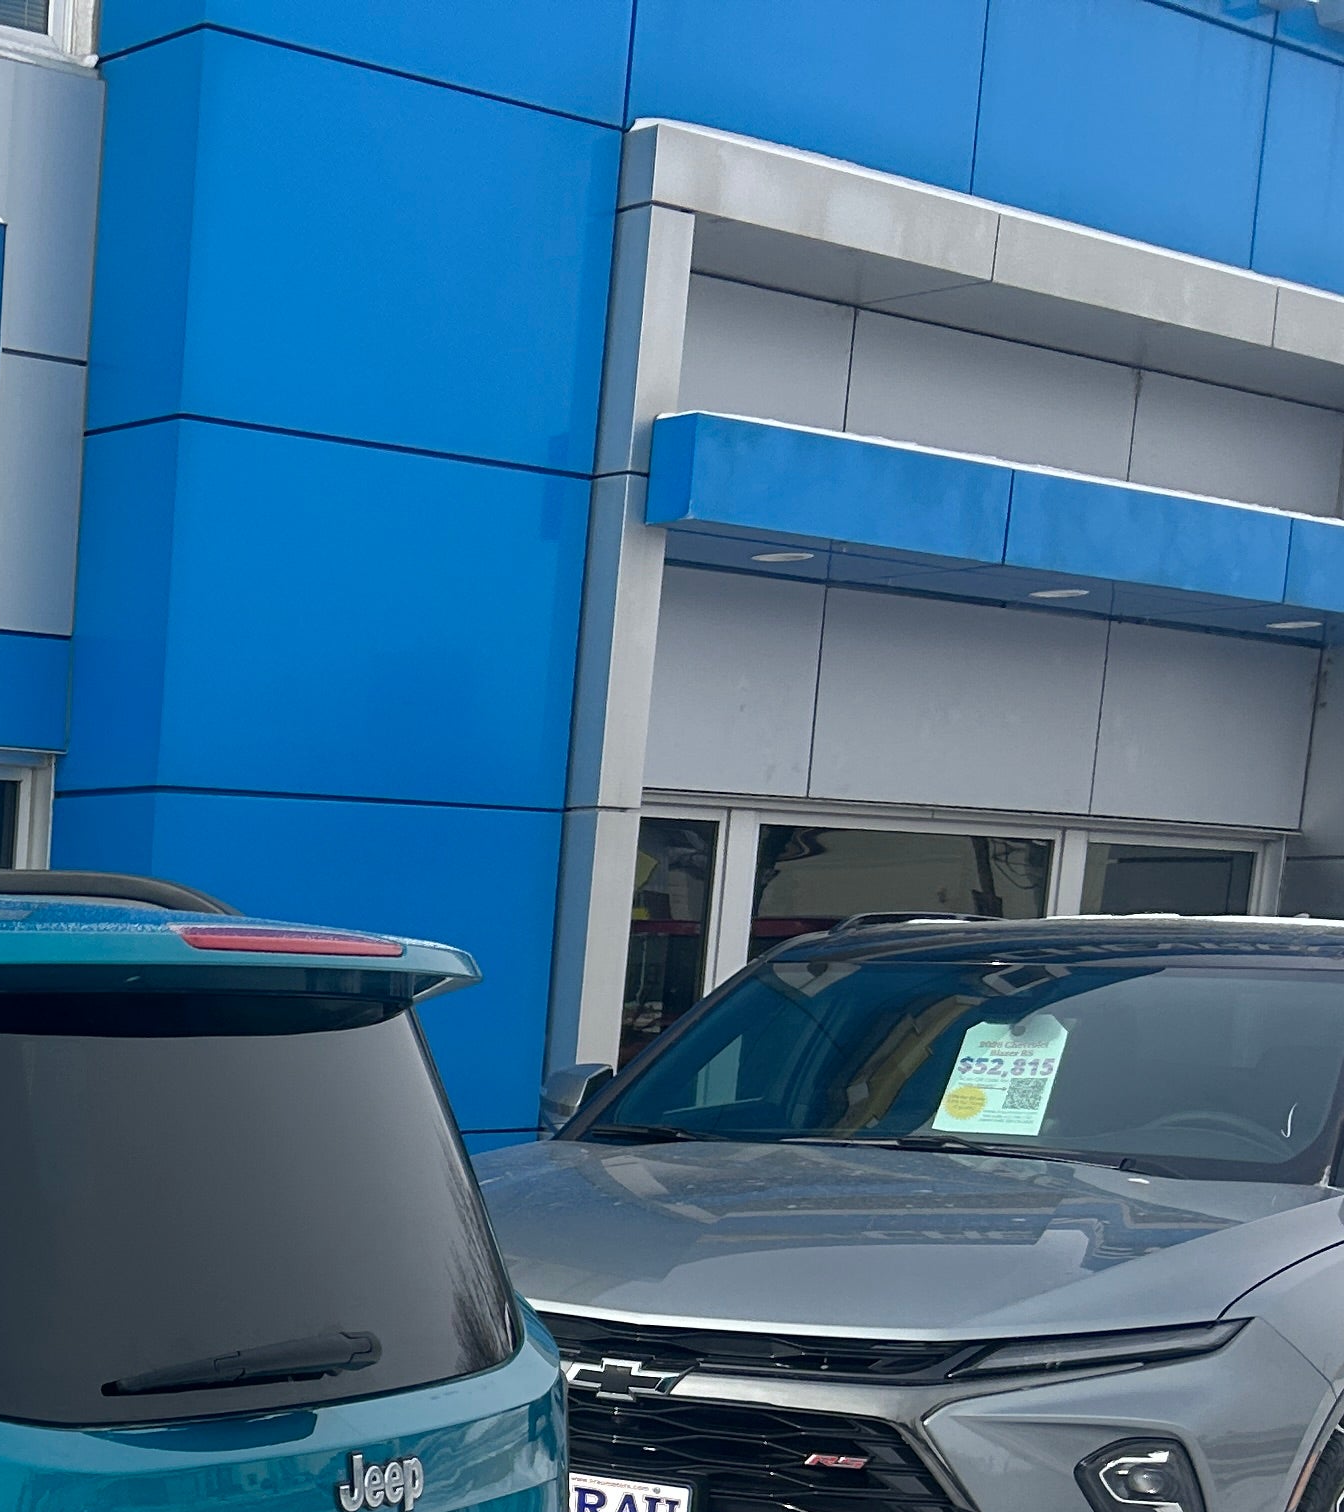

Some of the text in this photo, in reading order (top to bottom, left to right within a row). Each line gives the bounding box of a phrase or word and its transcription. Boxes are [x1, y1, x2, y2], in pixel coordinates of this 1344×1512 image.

[957, 1056, 1055, 1078] $52,815
[804, 1453, 870, 1470] RS
[339, 1454, 424, 1512] Jeep
